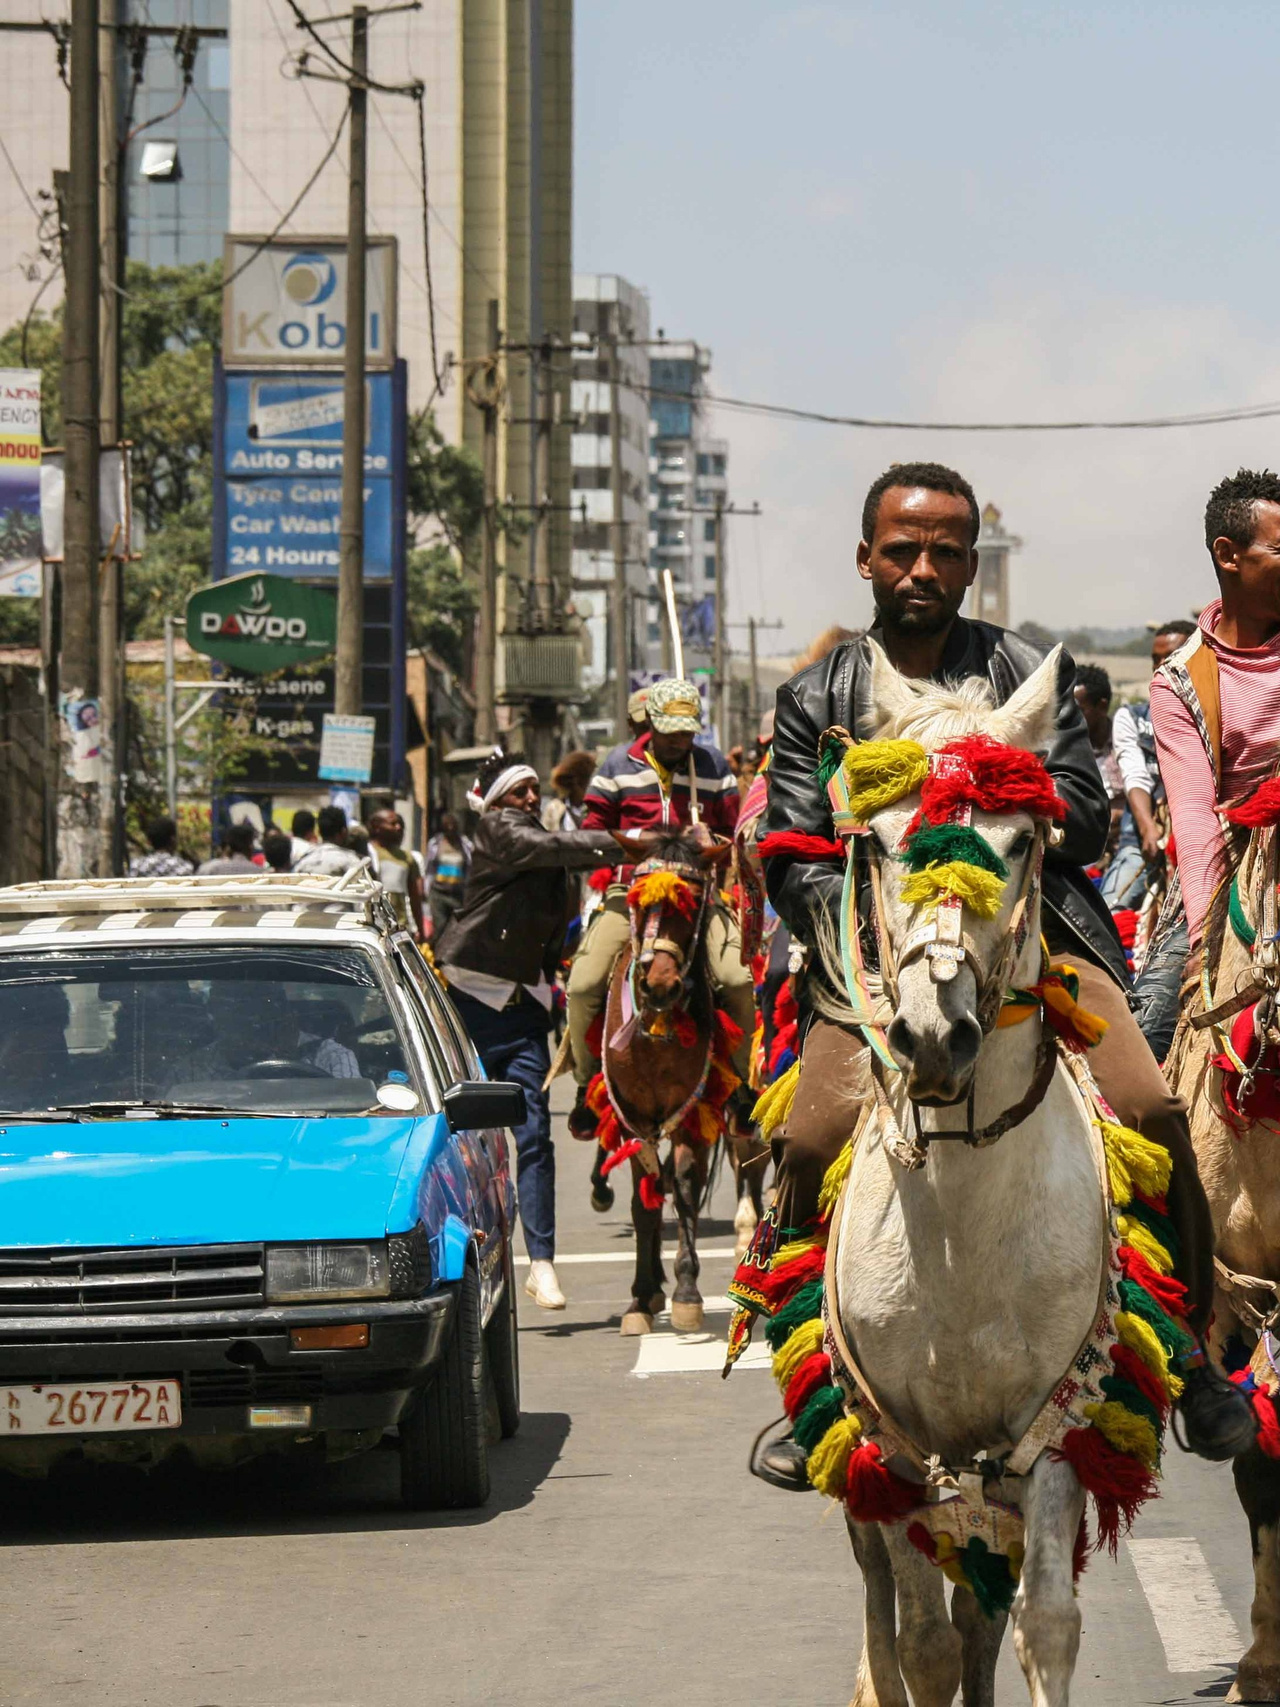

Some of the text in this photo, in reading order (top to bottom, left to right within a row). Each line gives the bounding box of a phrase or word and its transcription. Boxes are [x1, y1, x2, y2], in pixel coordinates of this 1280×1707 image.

[237, 311, 378, 349] Kobl
[231, 450, 388, 469] Auto Servce
[229, 483, 283, 507] Tyre
[230, 515, 274, 534] Car
[230, 547, 342, 565] 24 Hours
[157, 1386, 169, 1402] A
[47, 1387, 152, 1427] 26772
[157, 1405, 169, 1423] A
